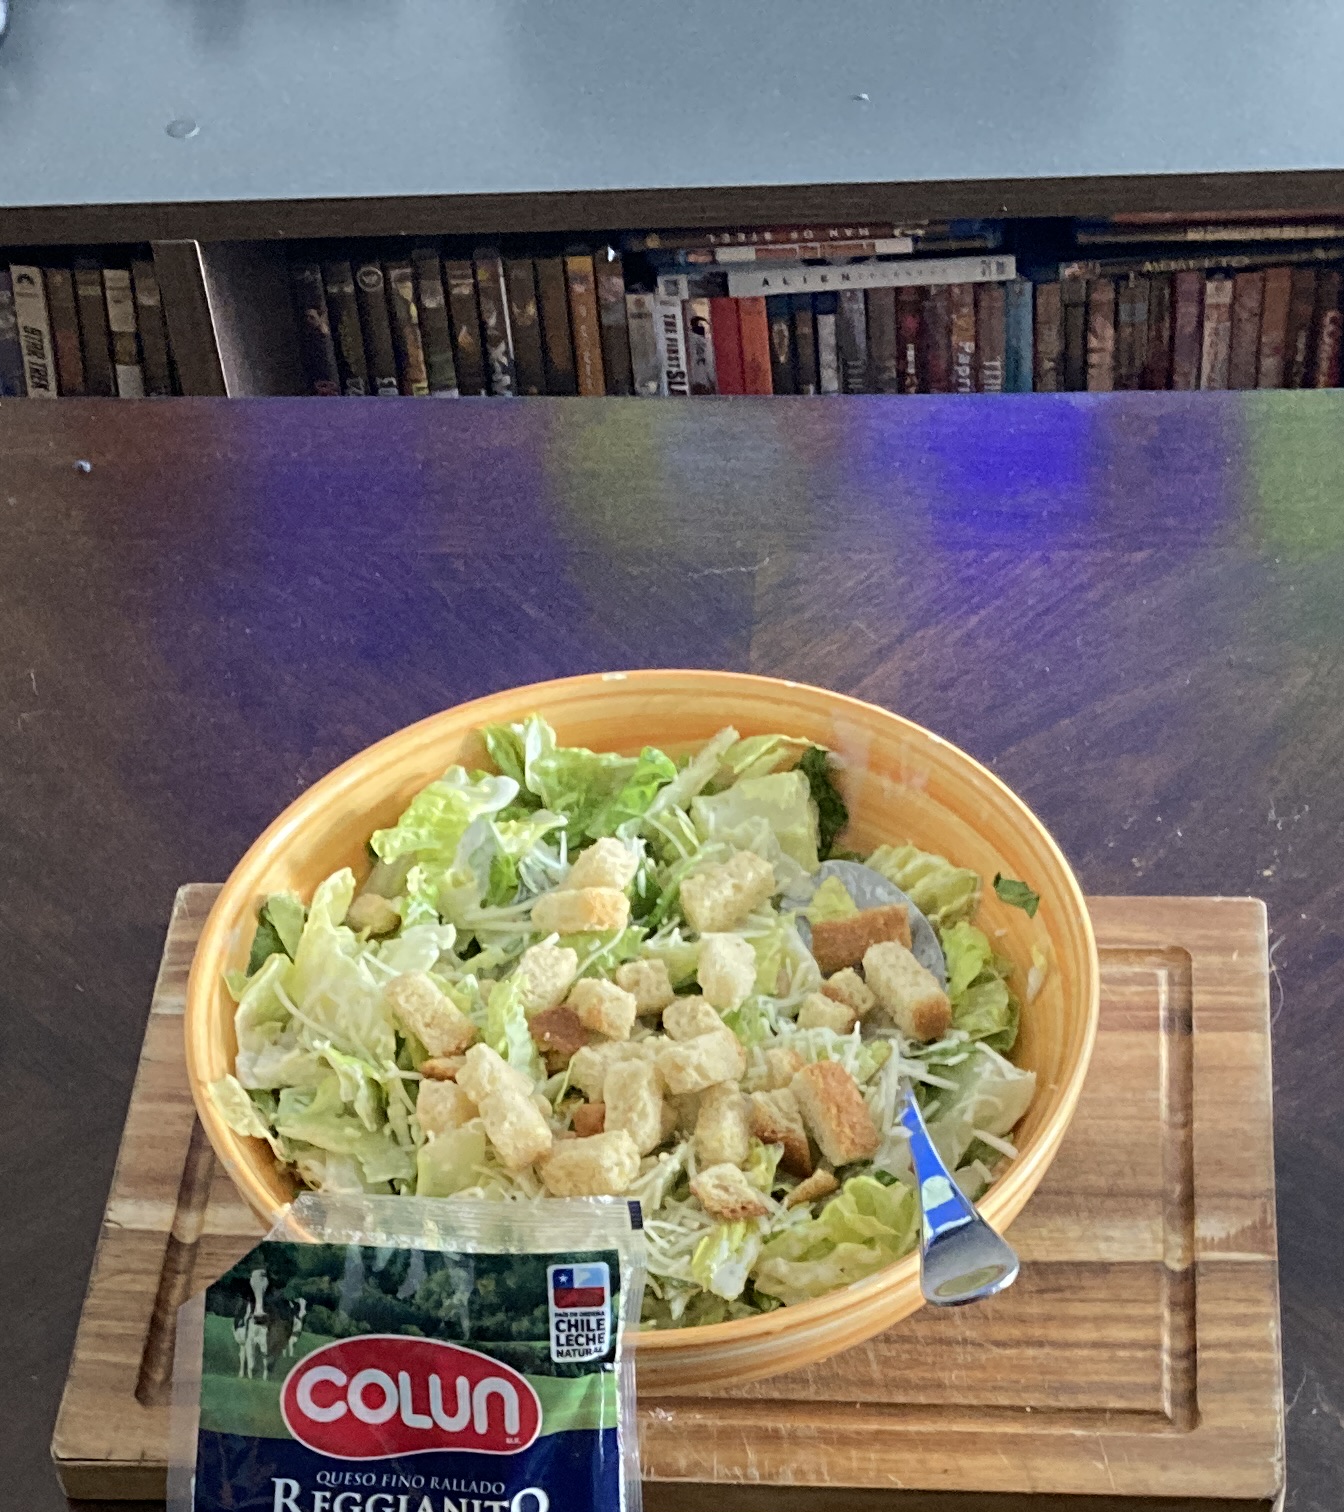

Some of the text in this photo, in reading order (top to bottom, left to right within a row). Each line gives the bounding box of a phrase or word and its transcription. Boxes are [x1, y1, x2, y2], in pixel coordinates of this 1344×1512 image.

[761, 272, 851, 287] ALIEN
[665, 337, 681, 369] FIRST
[555, 1318, 606, 1333] CHILE
[555, 1332, 606, 1347] LECHE
[296, 1365, 520, 1435] COLUN
[316, 1470, 506, 1495] QUESO FINO RALLADO
